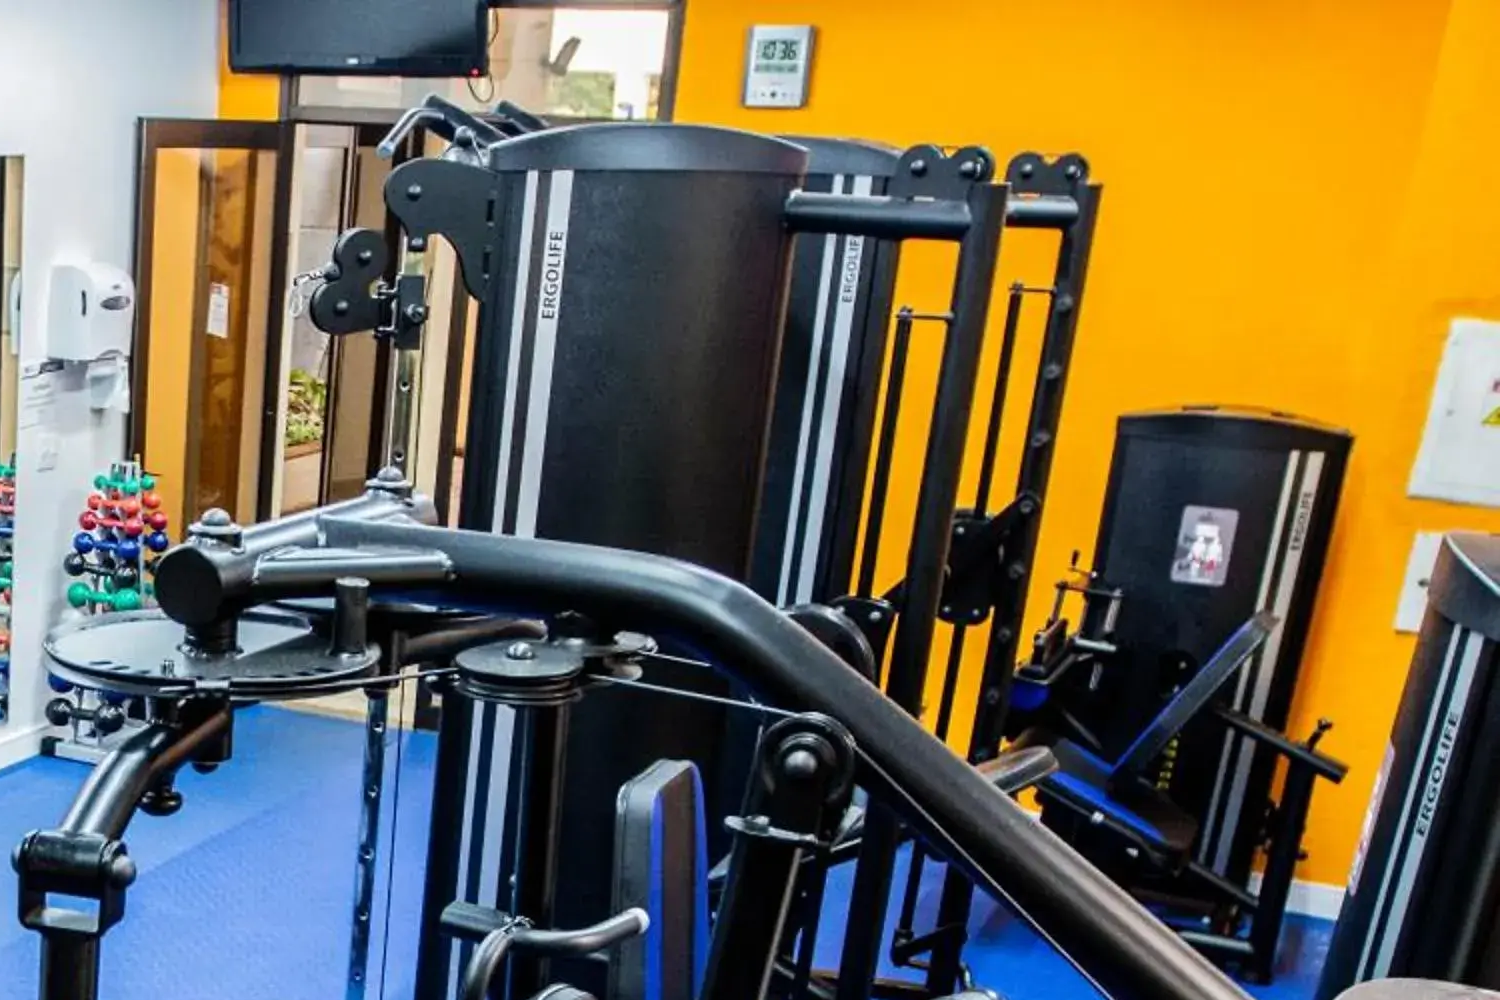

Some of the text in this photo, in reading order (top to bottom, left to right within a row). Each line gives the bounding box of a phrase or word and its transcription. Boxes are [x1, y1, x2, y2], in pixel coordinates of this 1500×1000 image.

[541, 231, 565, 320] ERGOLIFE
[841, 238, 861, 303] ERGOLIF
[1414, 711, 1459, 839] ERGOLIFE
